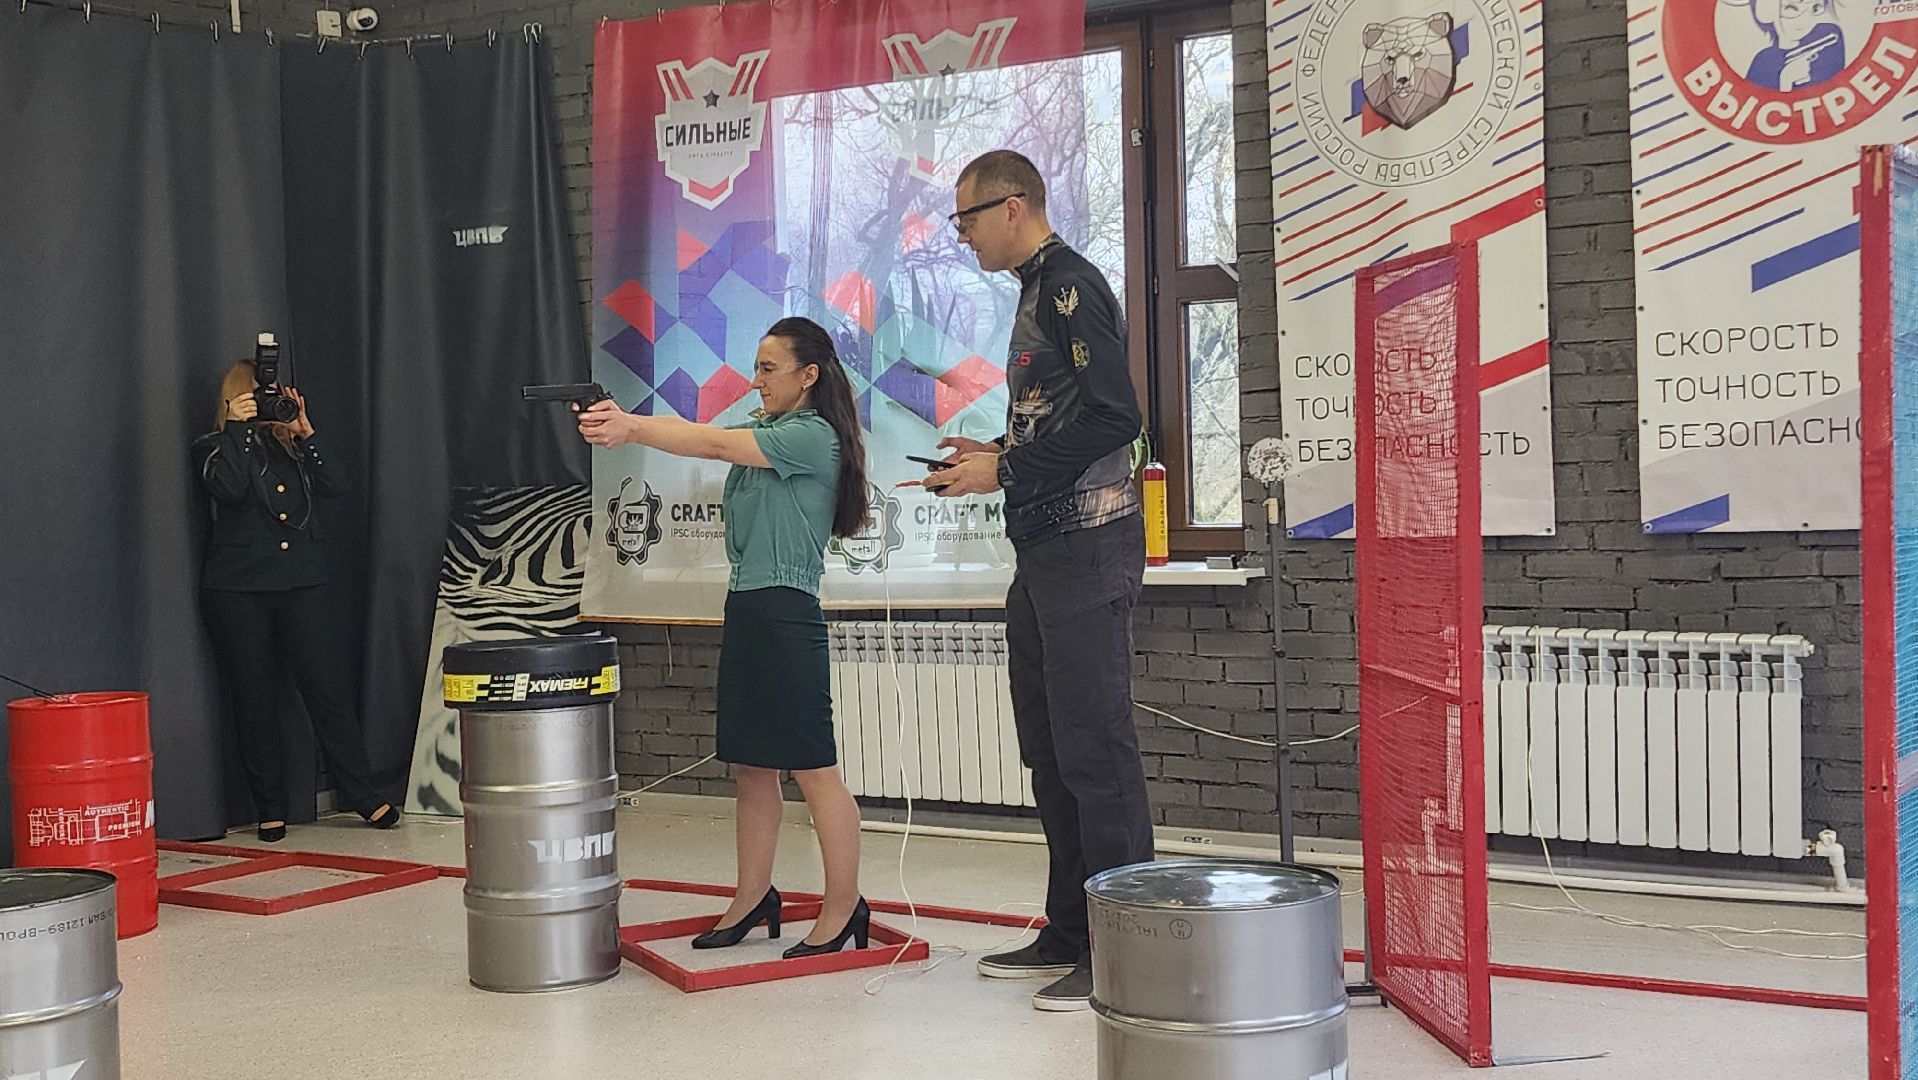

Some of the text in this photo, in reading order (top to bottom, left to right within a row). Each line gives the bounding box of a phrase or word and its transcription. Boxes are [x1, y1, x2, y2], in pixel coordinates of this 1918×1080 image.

[1874, 3, 1918, 16] ГОТОВ
[1301, 0, 1515, 182] ФЕДЕР ЧЕСКОЙ СТРЕЛЬБЫ РОССИИ
[1683, 36, 1917, 137] ВЫСТРЕЛ
[665, 117, 752, 147] СИЛЬНЫЕ
[1655, 322, 1839, 356] СКОРОСТЬ
[1295, 349, 1437, 379] СКОСТЬ
[1655, 370, 1841, 403] ТОЧНОСТЬ
[1295, 392, 1437, 421] ТОЧОСТЬ
[914, 503, 979, 526] CRAFT
[670, 528, 725, 540] IPSC оборудо
[936, 530, 1002, 542] оборудование
[528, 676, 589, 693] FREMAX
[84, 805, 130, 817] AUTHENTIC
